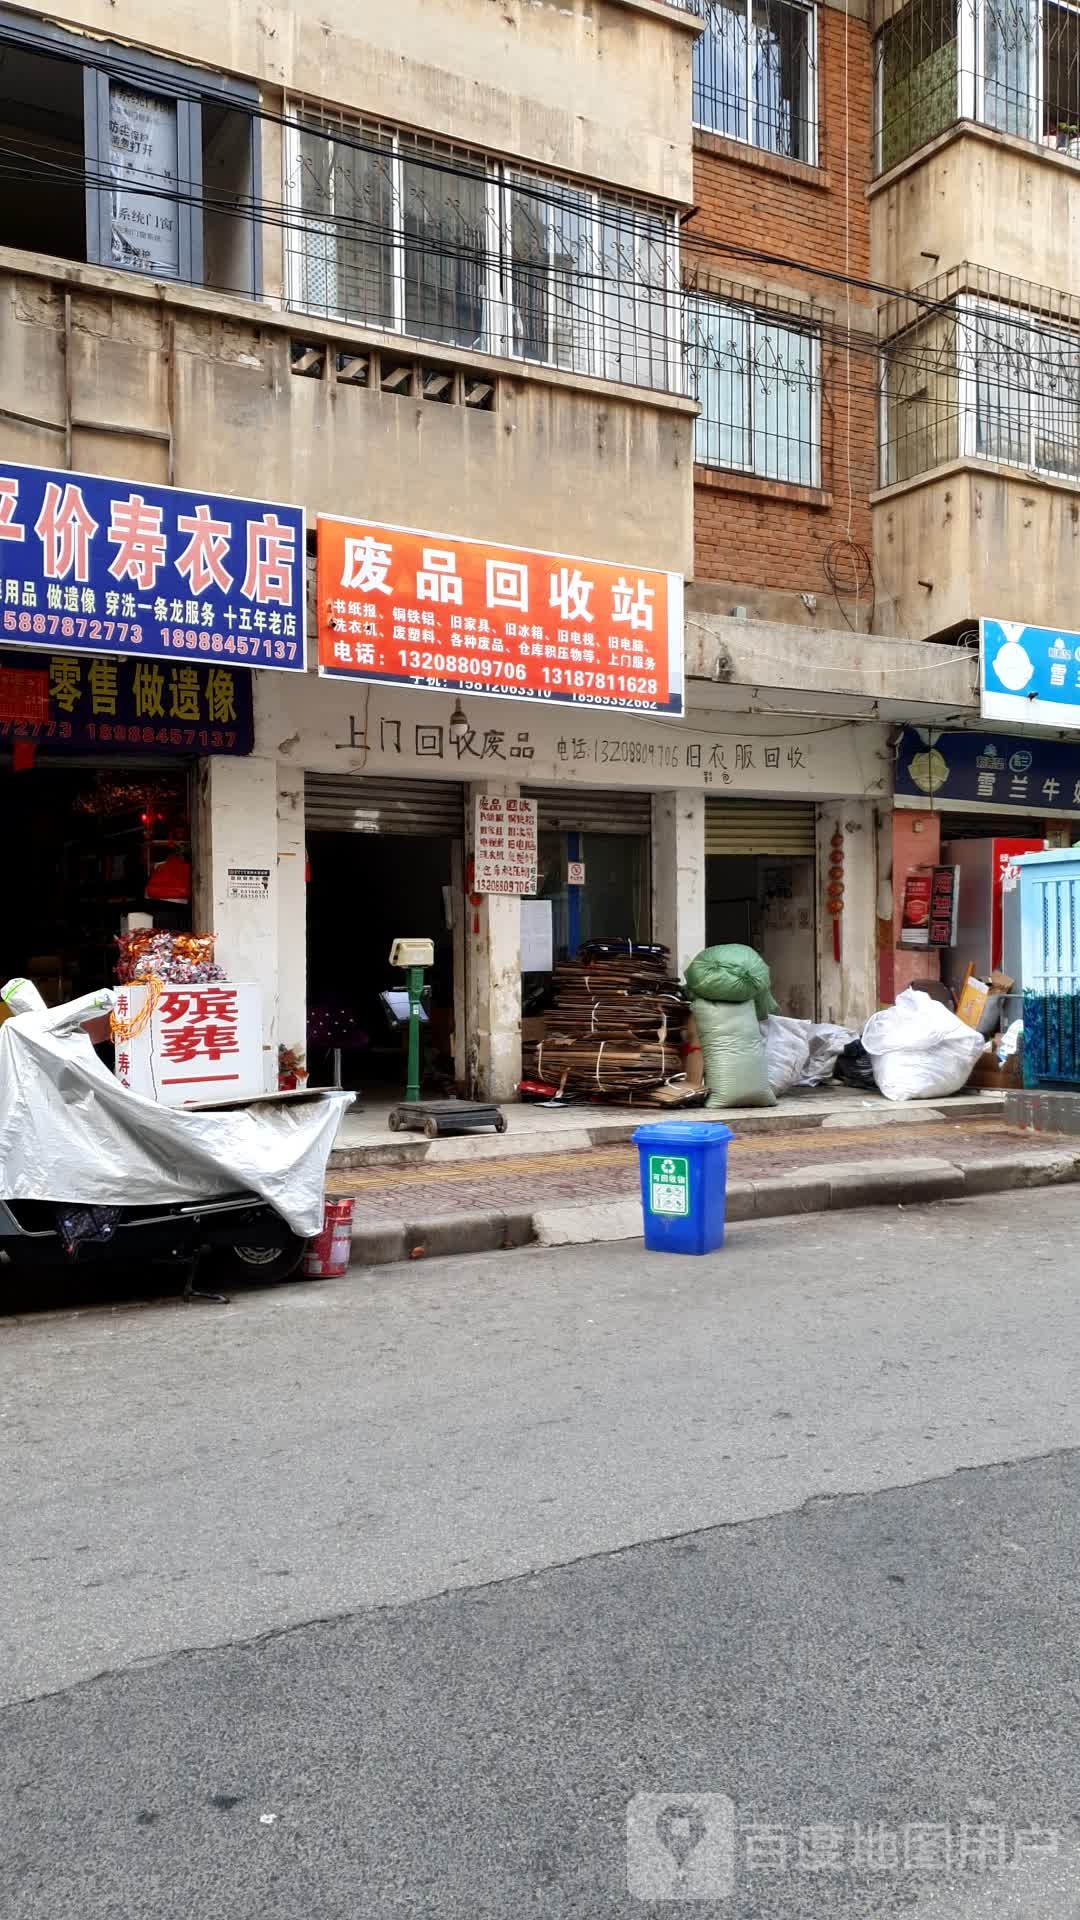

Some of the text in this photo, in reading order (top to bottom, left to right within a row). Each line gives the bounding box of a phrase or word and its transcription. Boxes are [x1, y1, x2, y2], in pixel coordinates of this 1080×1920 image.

[120, 207, 174, 232] 系统门窗
[0, 578, 297, 637] 用品 做遗像 穿洗一条龙服务 十五年老店
[340, 536, 655, 631] 废品回收站
[160, 628, 297, 660] 18988457137
[50, 657, 118, 716] 零售
[132, 663, 237, 724] 做遗像
[542, 667, 658, 695] 13187811628
[1050, 663, 1080, 688] 雪
[335, 715, 535, 760] 上门回收废品
[686, 743, 806, 770] 旧衣服回收
[159, 987, 240, 1103] 殡葬一
